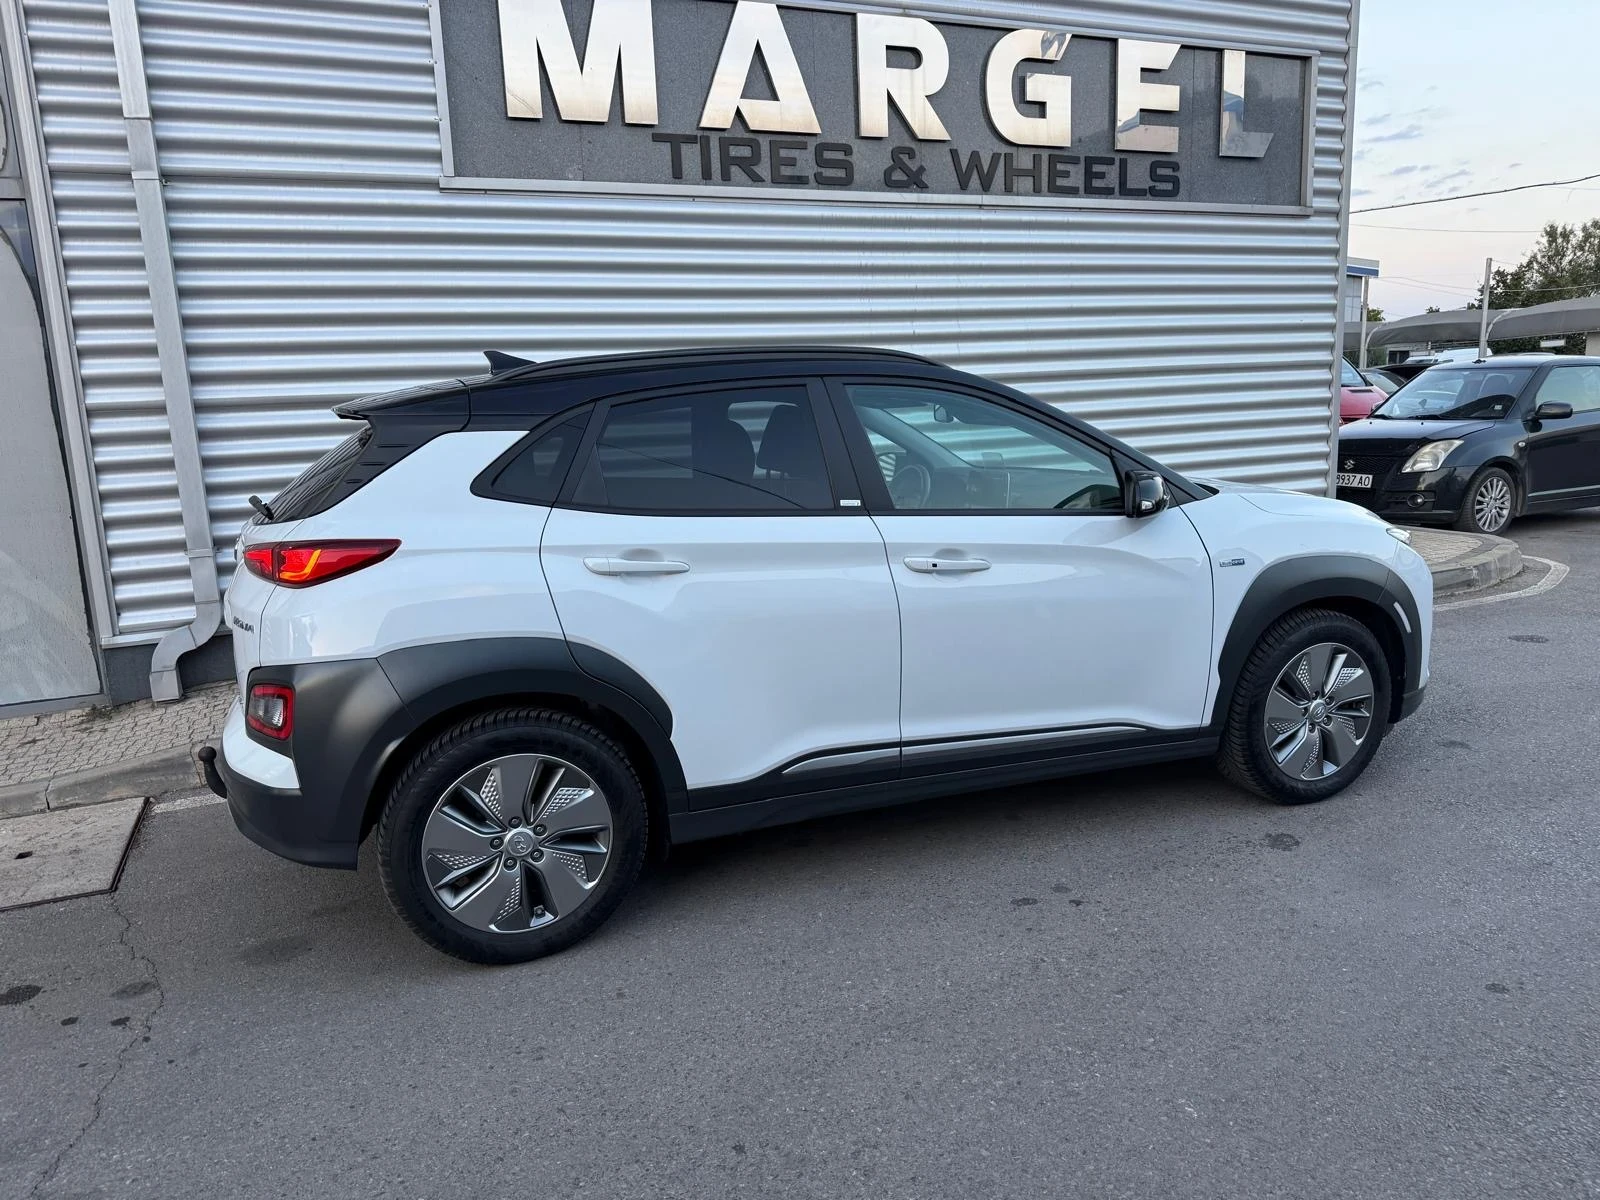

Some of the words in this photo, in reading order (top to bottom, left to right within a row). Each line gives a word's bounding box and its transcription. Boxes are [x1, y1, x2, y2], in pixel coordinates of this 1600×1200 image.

[497, 0, 1274, 158] MARGEL
[652, 132, 854, 186] TIRES
[883, 146, 929, 189] &
[949, 148, 1181, 198] WHEELS
[1357, 475, 1371, 487] AO
